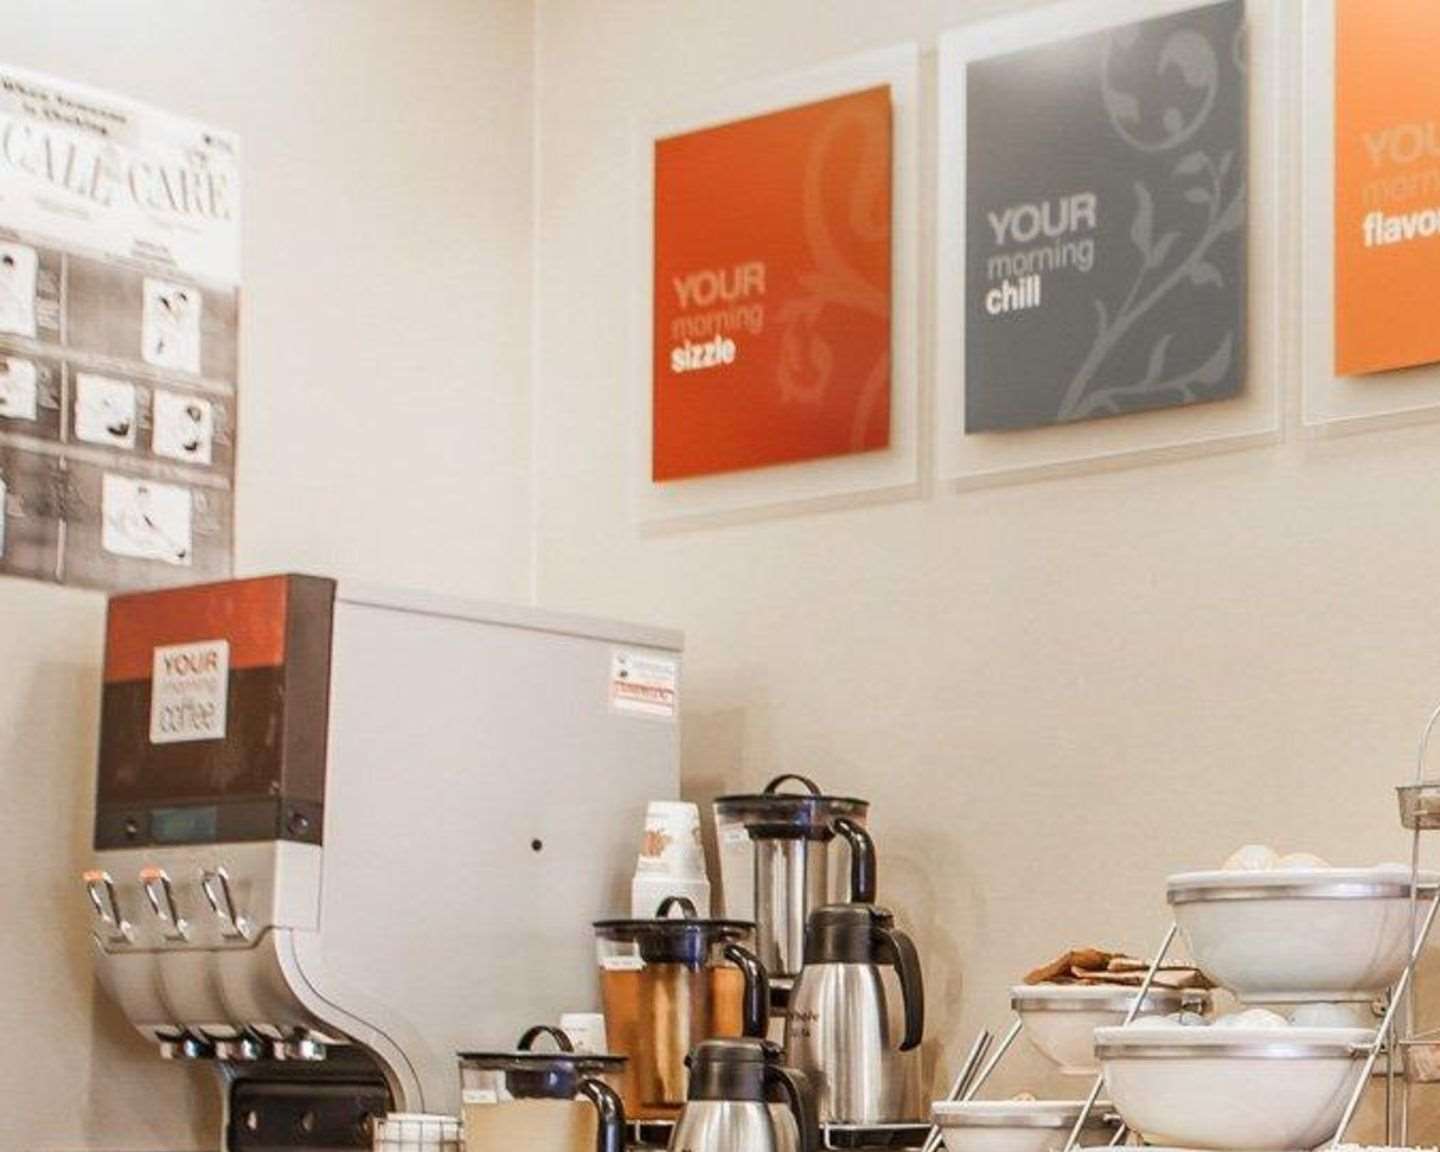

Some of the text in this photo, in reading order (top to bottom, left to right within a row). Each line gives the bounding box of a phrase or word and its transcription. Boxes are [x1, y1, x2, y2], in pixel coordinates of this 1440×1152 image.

[987, 192, 1097, 245] YOUR
[987, 238, 1095, 279] morning
[672, 261, 767, 309] YOUR
[985, 273, 1041, 315] chill
[671, 304, 764, 340] morning
[670, 334, 737, 373] sizzle
[163, 652, 218, 677] YOUR
